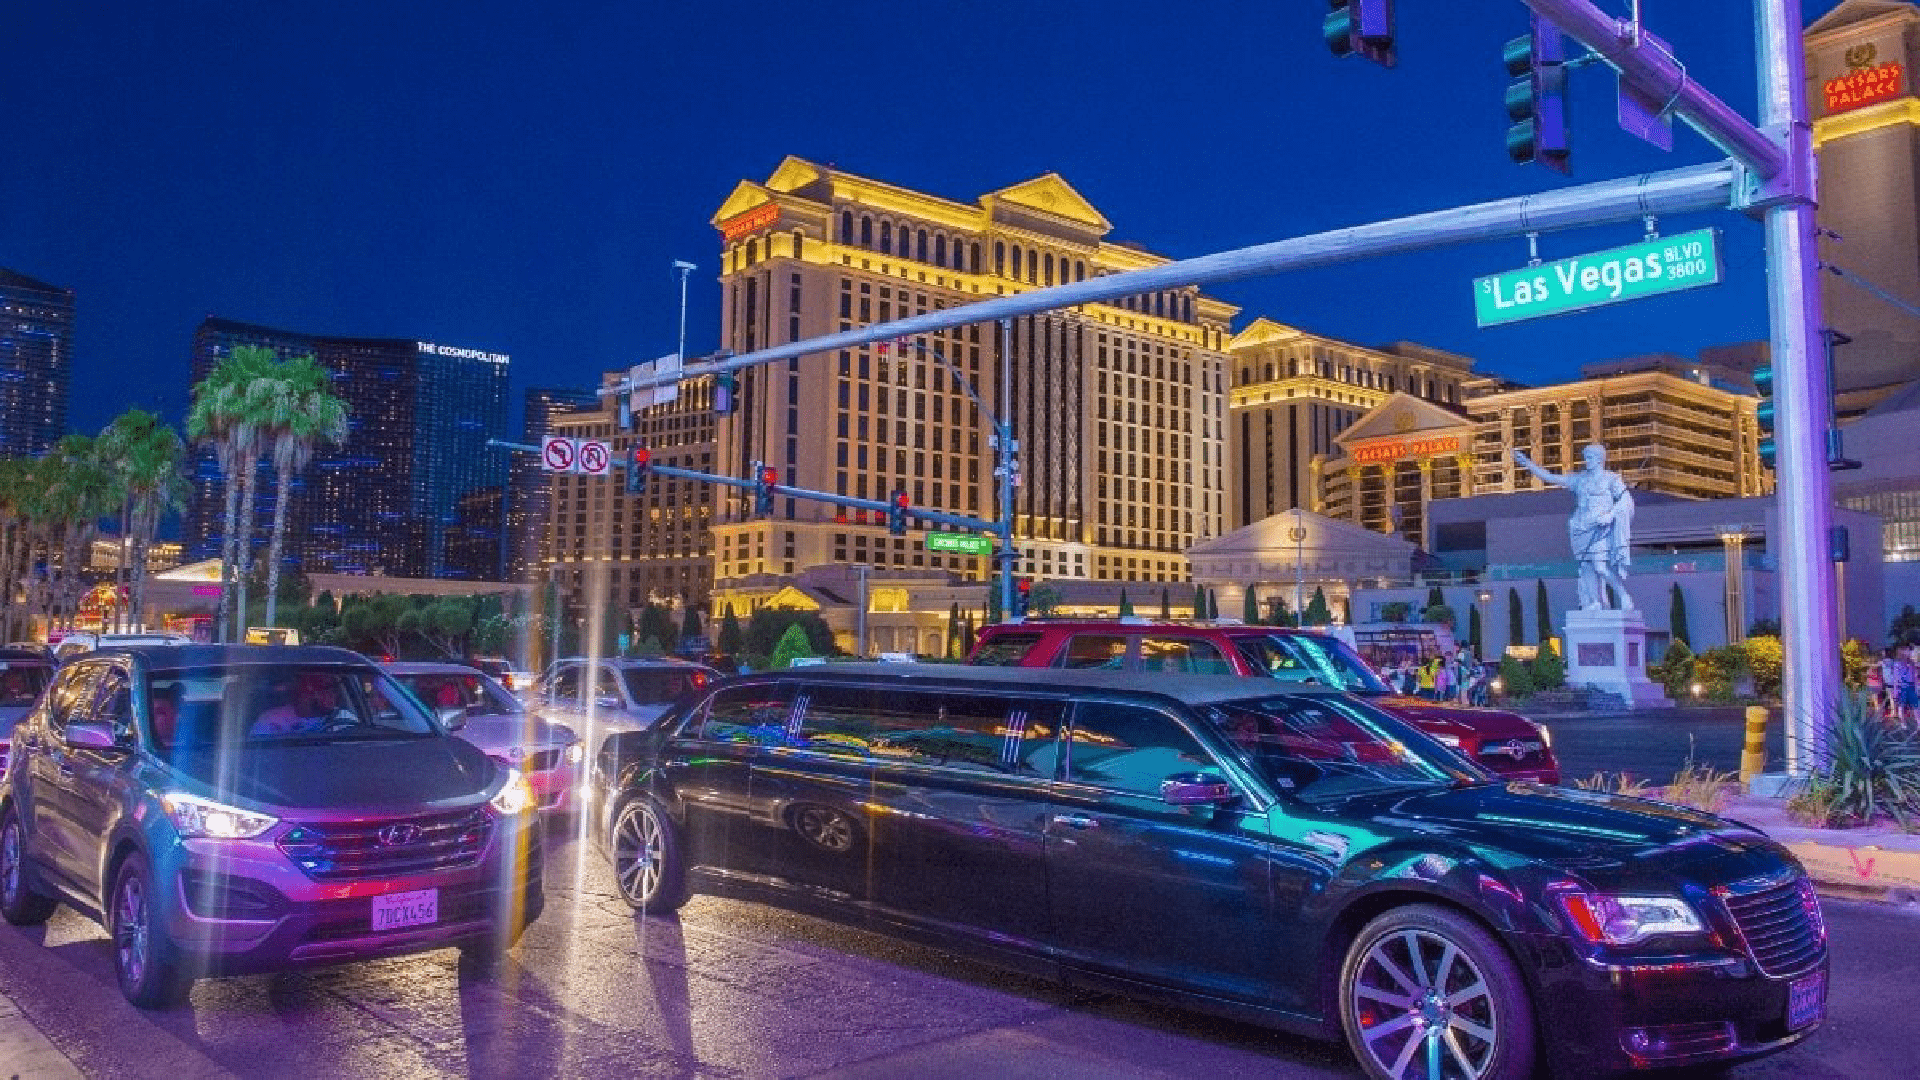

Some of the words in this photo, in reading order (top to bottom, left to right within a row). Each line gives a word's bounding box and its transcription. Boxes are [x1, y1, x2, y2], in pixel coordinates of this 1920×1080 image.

[1825, 65, 1899, 94] CAESARS
[1829, 80, 1895, 108] PALACE
[1482, 279, 1492, 294] S
[1493, 275, 1550, 310] Las
[1554, 252, 1662, 299] Vegas
[1663, 241, 1702, 263] BLVD
[1666, 258, 1707, 281] 3800
[417, 341, 436, 355] THE
[438, 345, 510, 364] COSMOPOLITAN
